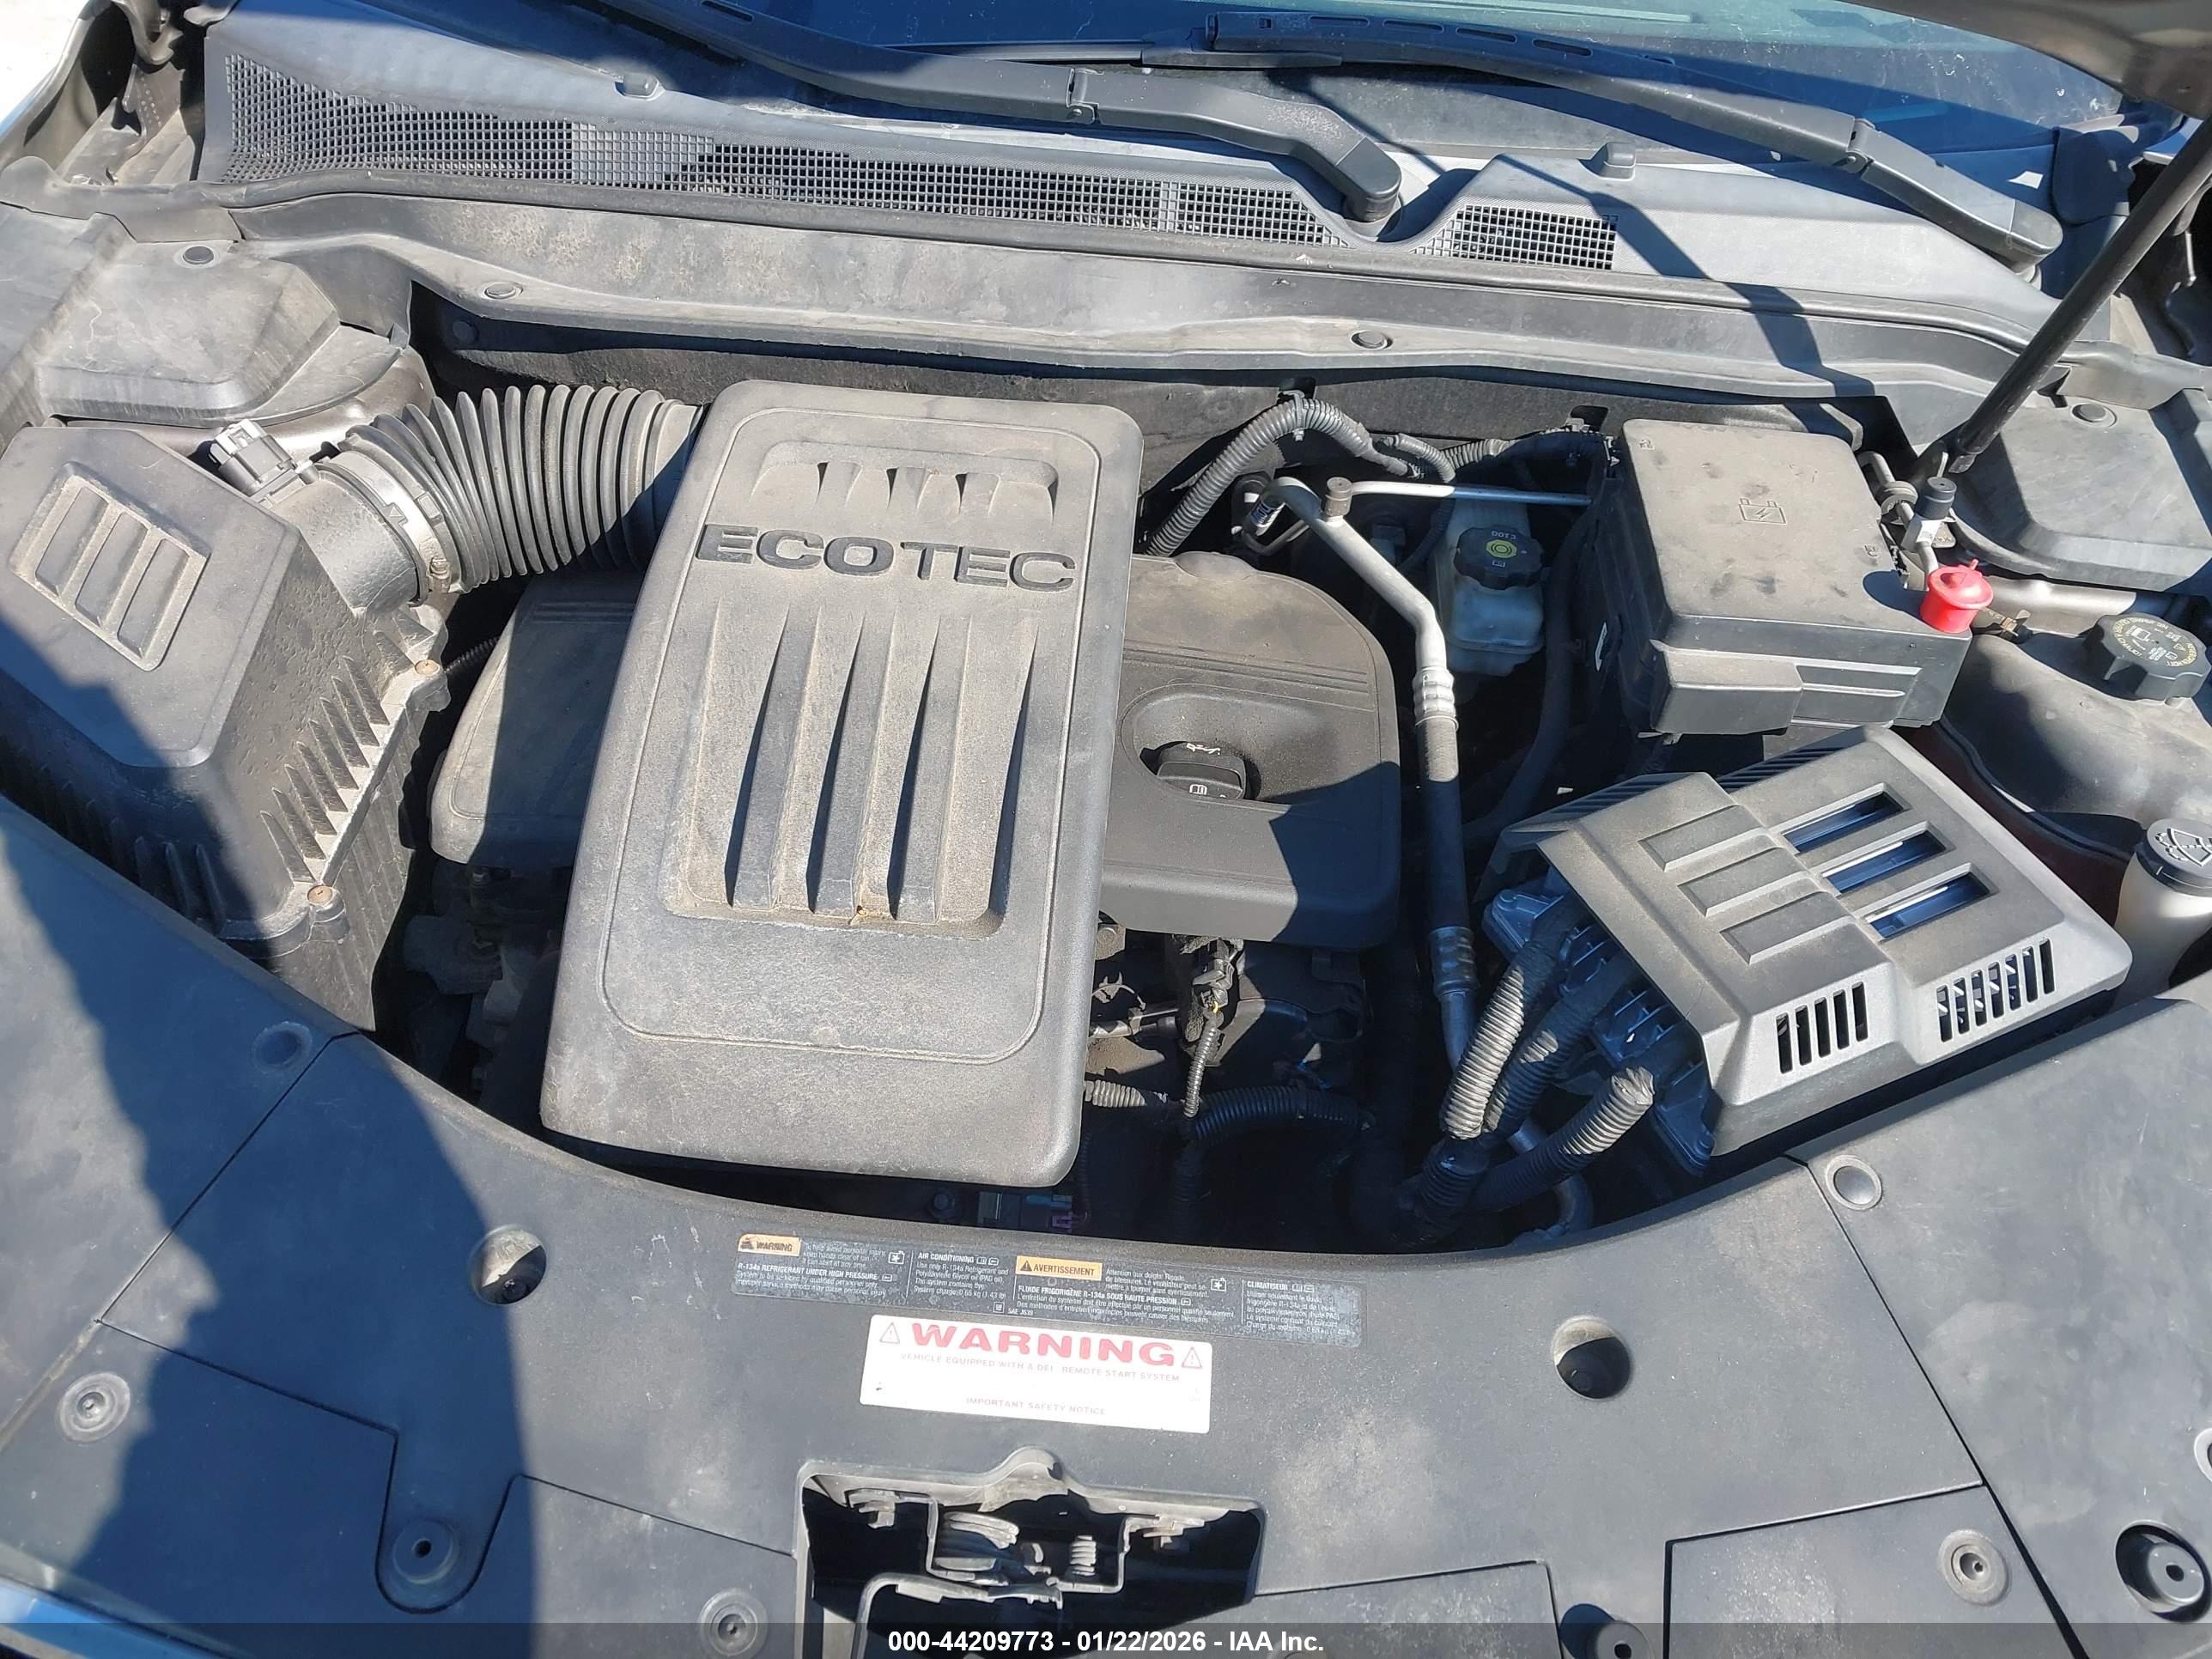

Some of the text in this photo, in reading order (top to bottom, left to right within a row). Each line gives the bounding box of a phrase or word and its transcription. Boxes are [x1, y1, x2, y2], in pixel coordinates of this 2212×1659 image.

[696, 523, 1076, 592] ECOTEC
[917, 1251, 975, 1263] AIR CONDITIONING
[761, 1264, 805, 1274] REFRIGERANT
[805, 1267, 827, 1276] UNDER
[828, 1269, 843, 1278] HIGH
[844, 1270, 878, 1280] PRESSURE
[941, 1263, 963, 1272] R-134a
[964, 1265, 996, 1276] Refrigerant
[1032, 1263, 1095, 1276] AVERTISSEMENT
[926, 1278, 948, 1287] system
[1018, 1285, 1040, 1293] FLUIDE
[1082, 1290, 1105, 1298] R-134a
[1106, 1291, 1123, 1300] SOUS
[1124, 1293, 1145, 1302] HAUTE
[1146, 1295, 1177, 1305] PRESSION
[911, 1322, 1176, 1367] WARNING
[900, 1351, 942, 1363] VEHICLE
[945, 1355, 995, 1367] EQUIPPED
[998, 1358, 1024, 1370] WITH
[1060, 1364, 1102, 1376] REMOTE
[1104, 1368, 1137, 1379] START
[1139, 1370, 1180, 1382] SYSTEM
[965, 1395, 1107, 1415] IMPORTANT SAFETY NOTICE
